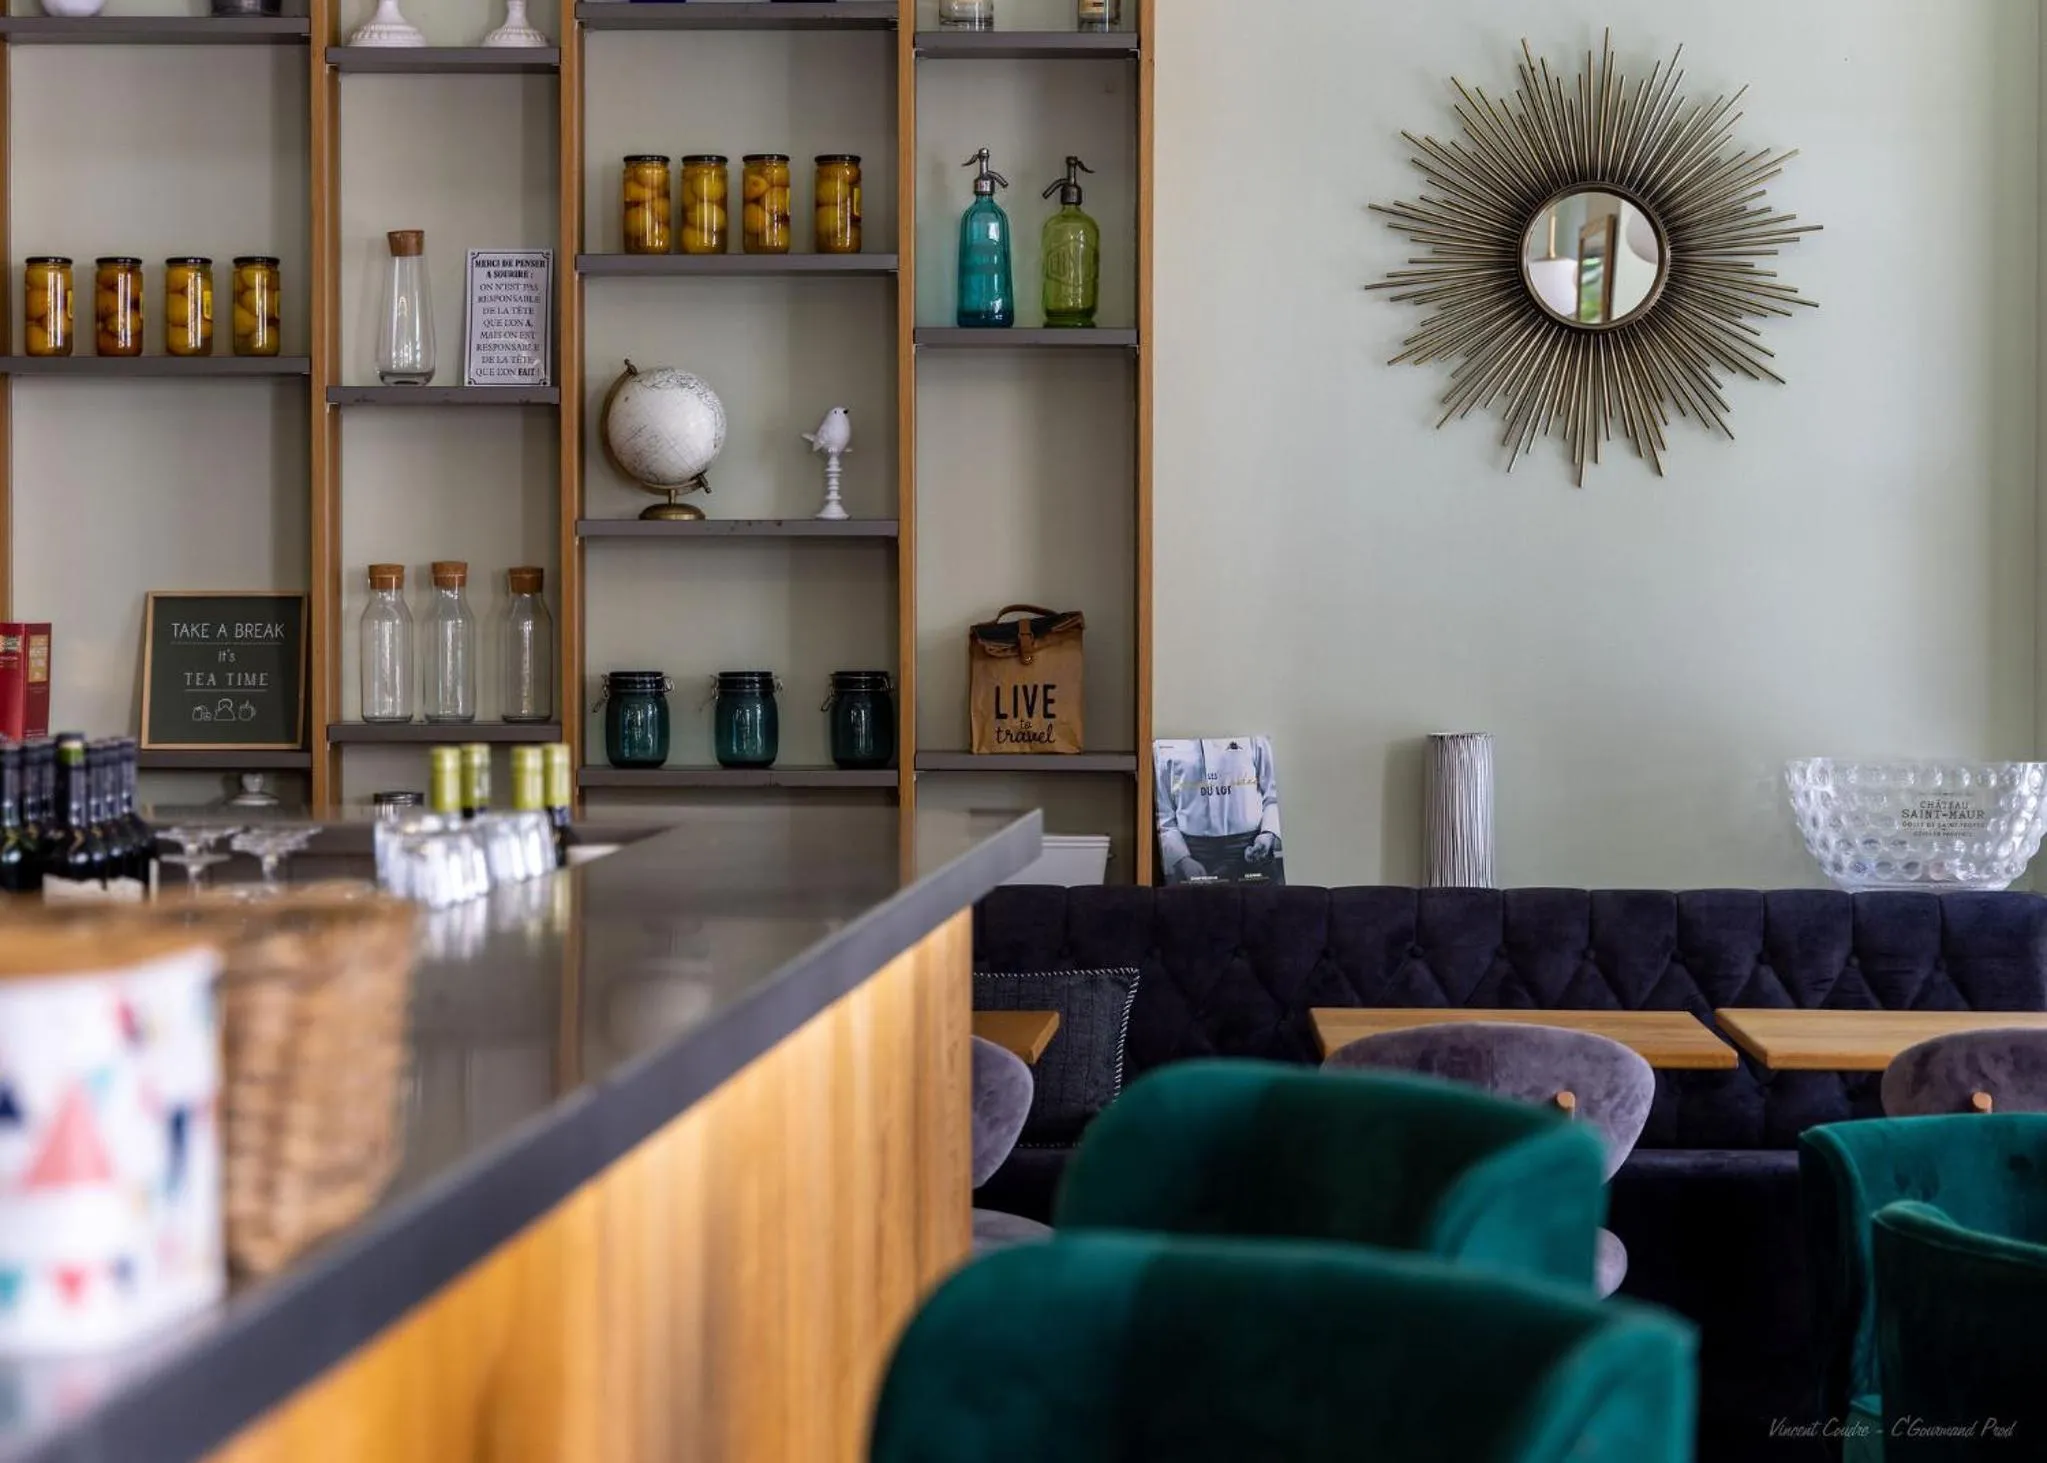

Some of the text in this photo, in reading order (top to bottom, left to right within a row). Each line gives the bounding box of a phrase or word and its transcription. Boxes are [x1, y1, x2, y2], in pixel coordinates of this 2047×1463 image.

[475, 259, 546, 268] MERCI DE PENSER
[479, 283, 493, 291] ON
[522, 283, 539, 291] PAS
[478, 295, 541, 303] RESPONSABLE
[482, 305, 535, 315] DE LA TÊTE
[482, 319, 503, 328] QUE
[476, 343, 541, 352] RESPONSABLE
[481, 356, 496, 364] DE
[497, 356, 509, 364] LA
[475, 367, 495, 377] QUE
[518, 367, 536, 376] FAIT
[171, 623, 285, 639] TAKE A BREAK
[183, 672, 269, 687] TEA TIME
[994, 684, 1057, 720] LIVE
[1020, 719, 1033, 730] to
[995, 722, 1056, 744] travel
[1200, 786, 1213, 796] DU
[1919, 799, 1969, 810] CHÂTEAU
[1901, 808, 1986, 820] SAINT-MAUR
